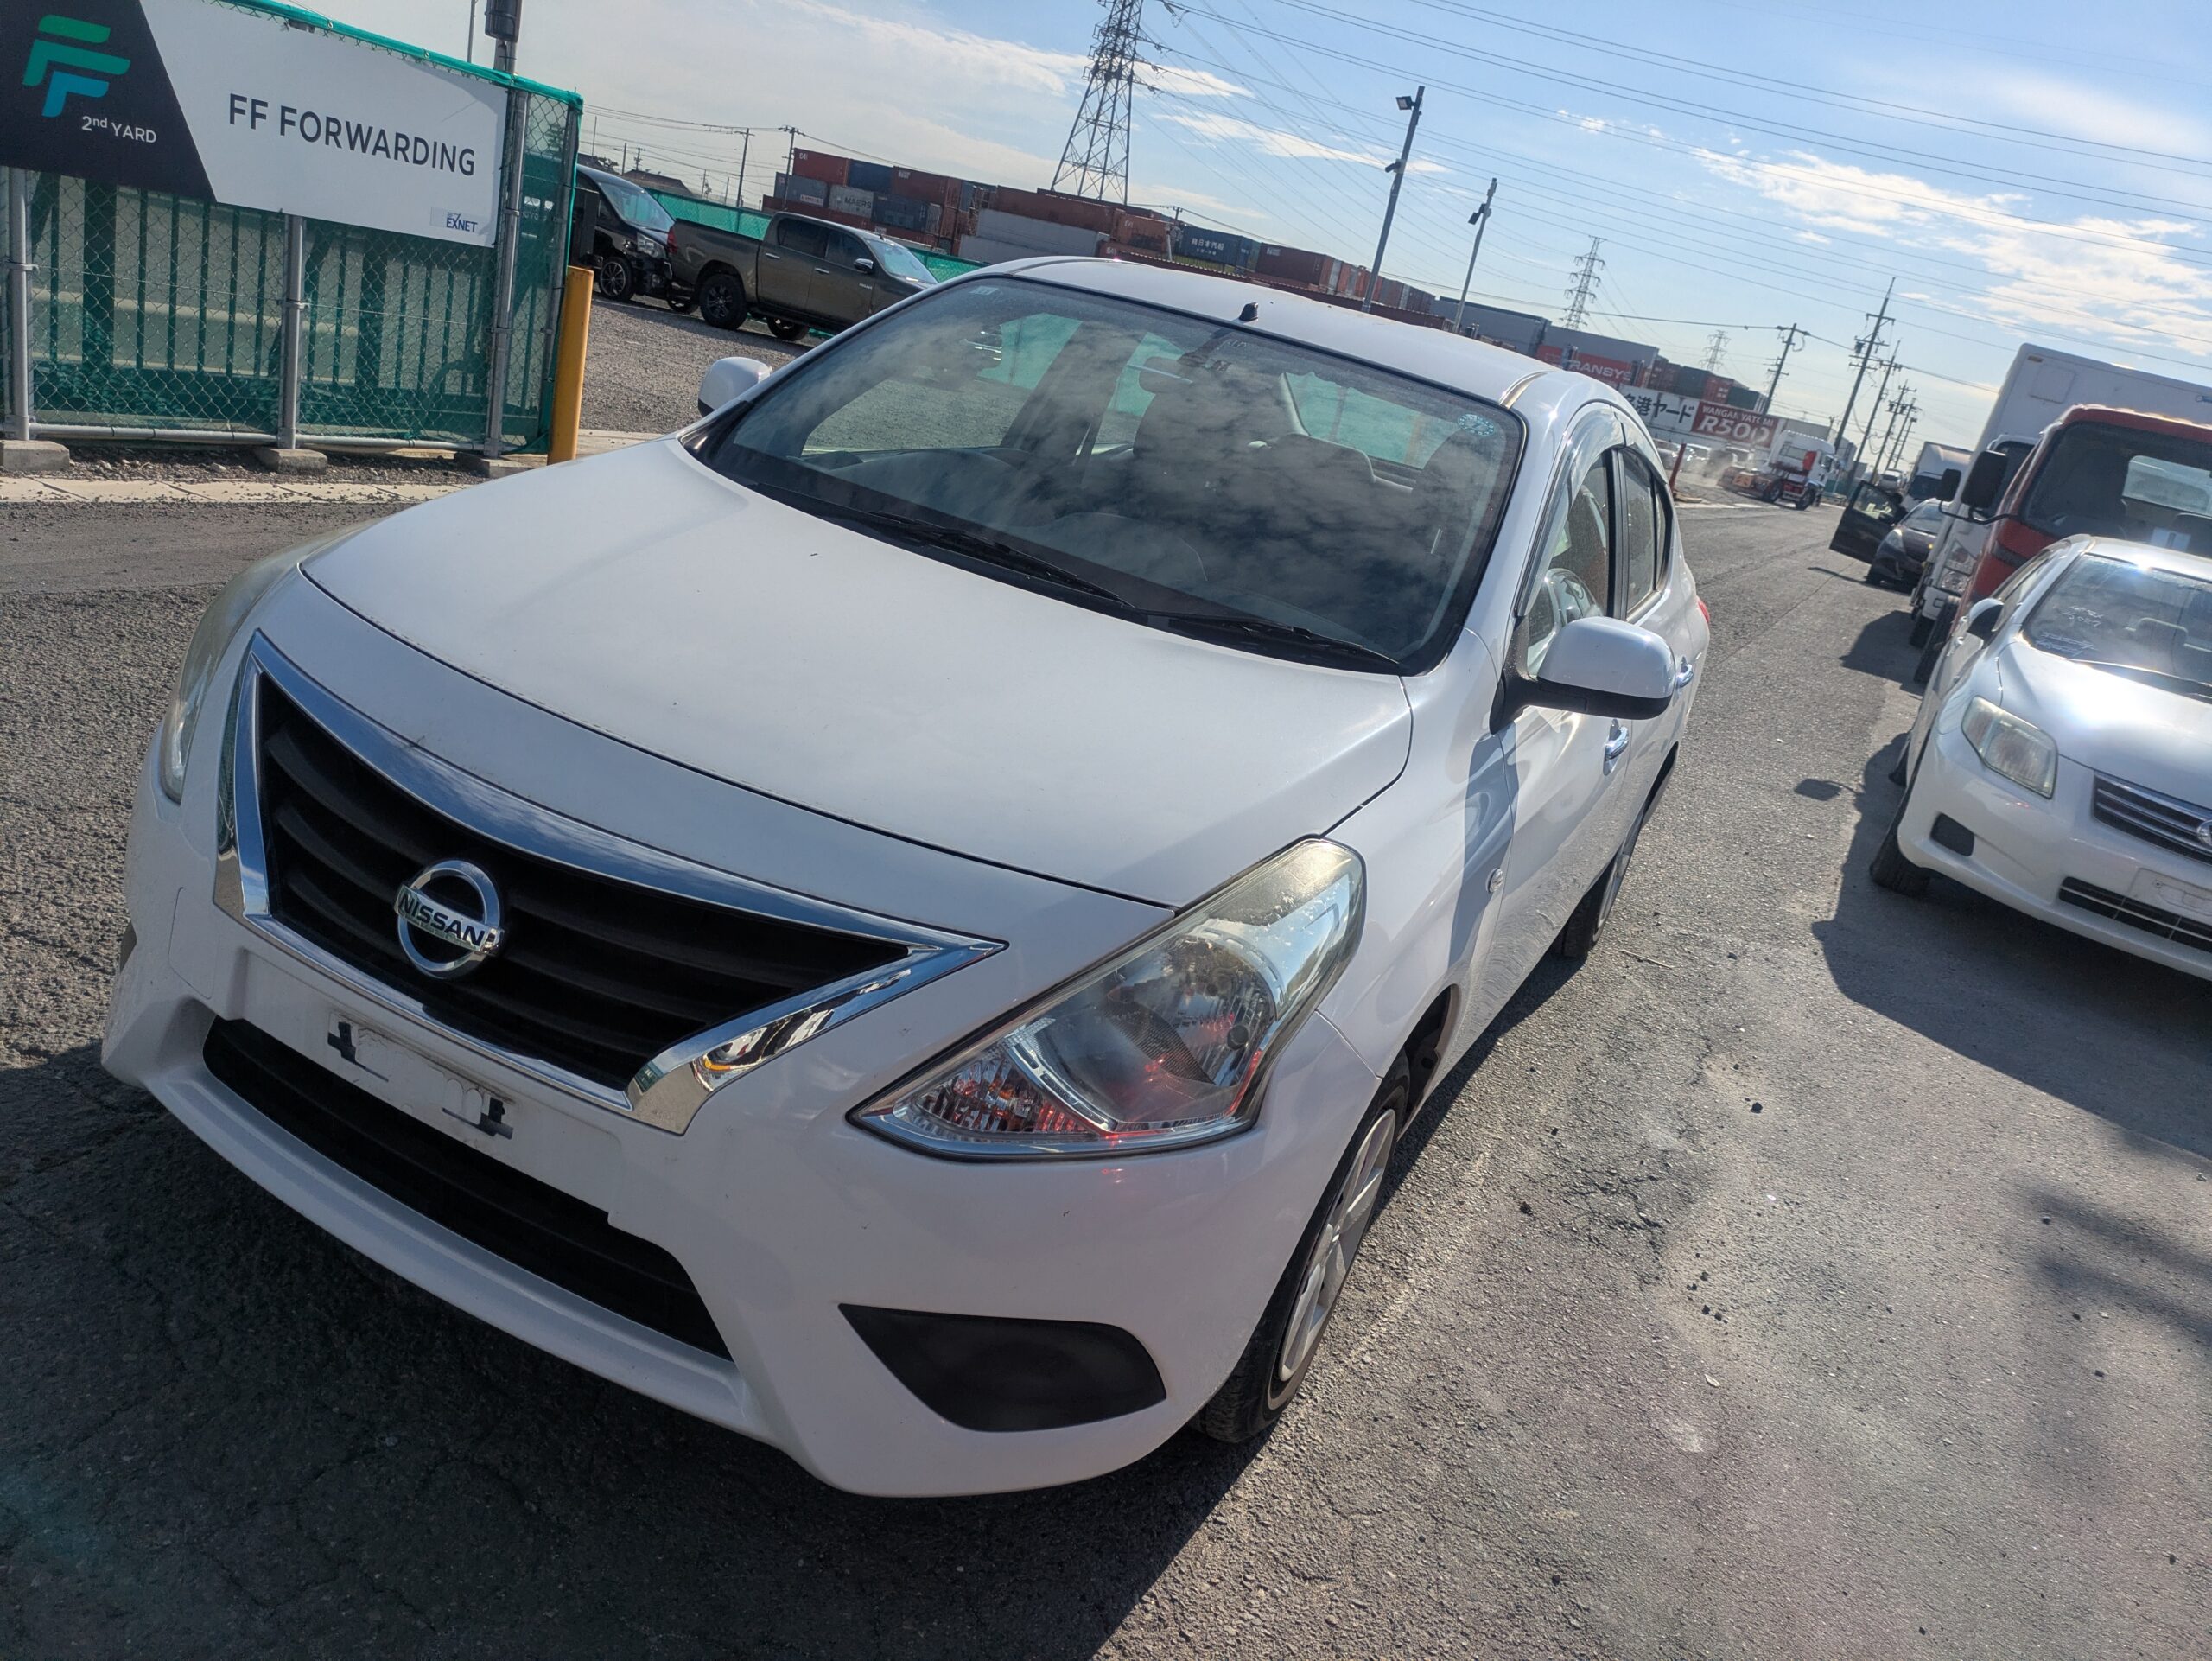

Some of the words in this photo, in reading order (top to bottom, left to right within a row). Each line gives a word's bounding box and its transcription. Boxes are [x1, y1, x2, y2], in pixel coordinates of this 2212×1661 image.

[81, 115, 108, 132] 2nd
[111, 122, 157, 143] YARD
[229, 93, 269, 130] FF
[279, 105, 475, 176] FORWARDING
[446, 213, 478, 233] EXNET
[398, 893, 486, 946] NISSAN
